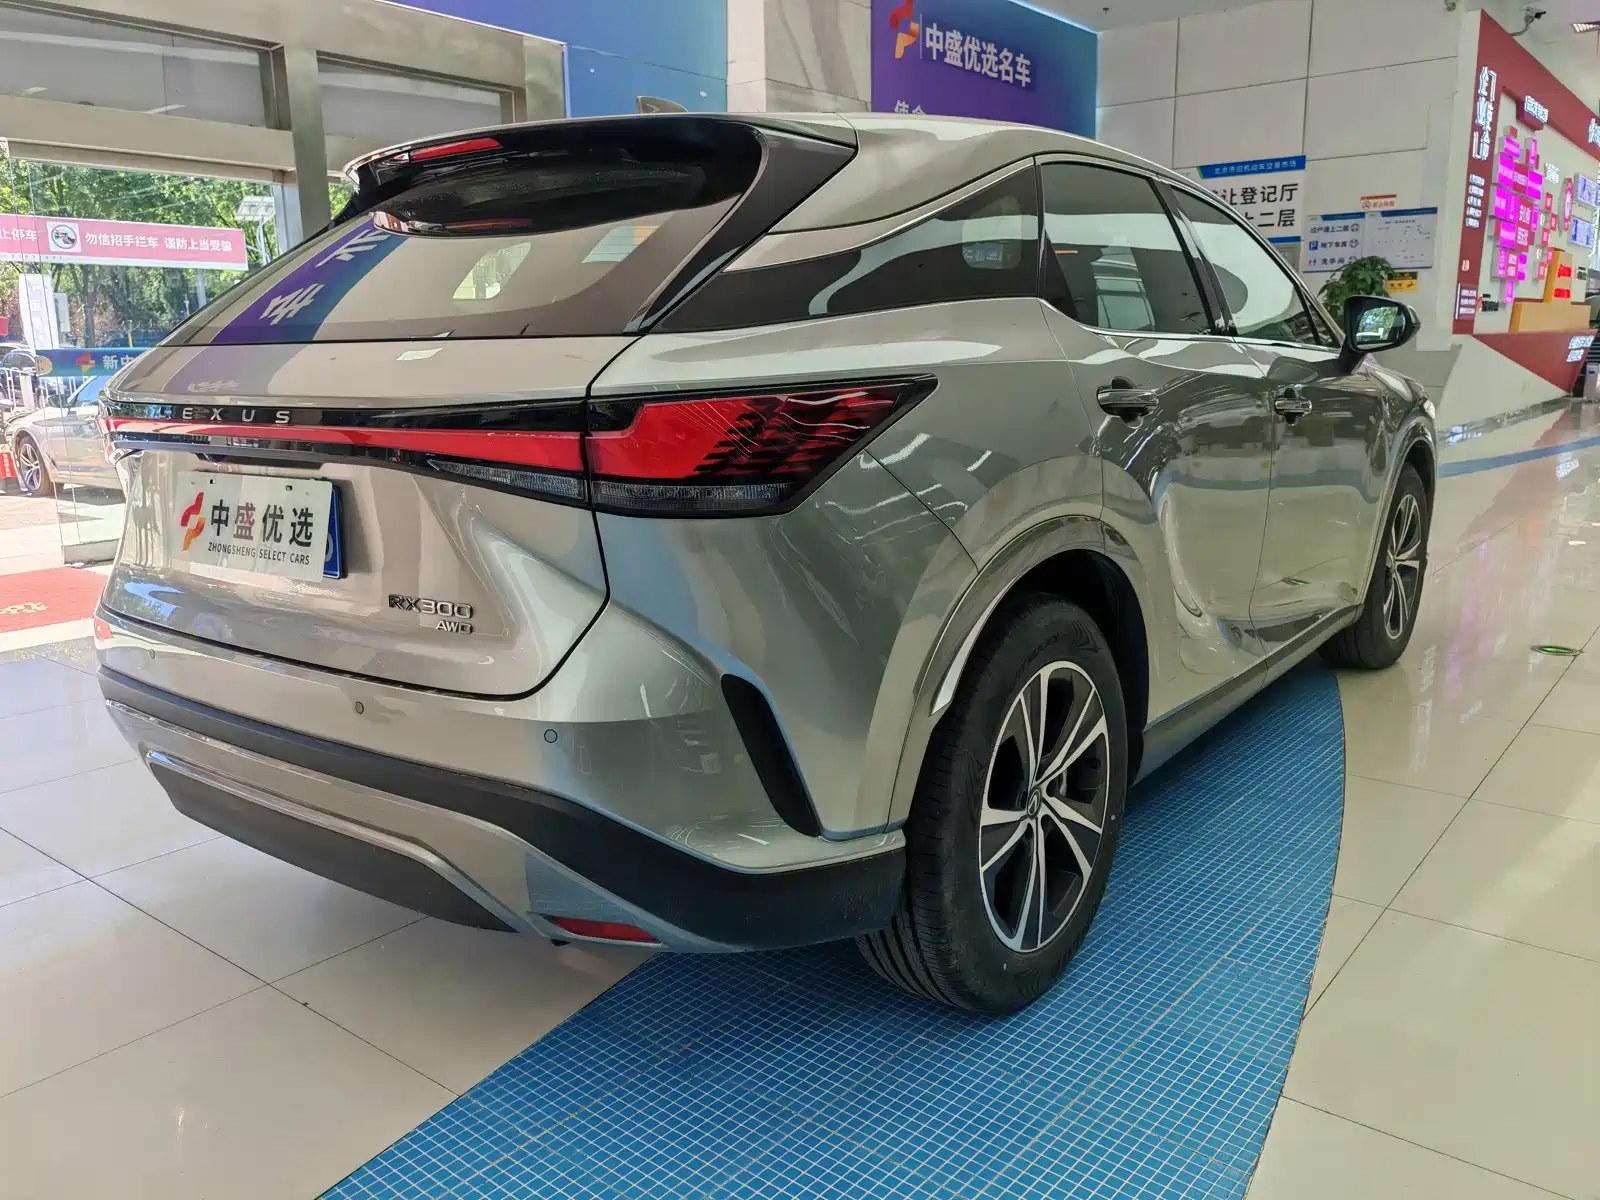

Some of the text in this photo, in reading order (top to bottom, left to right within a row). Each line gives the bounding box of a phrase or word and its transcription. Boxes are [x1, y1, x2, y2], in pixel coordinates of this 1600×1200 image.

[925, 22, 1032, 88] 中盛优选名车
[1212, 183, 1299, 206] 让登记厅
[84, 232, 159, 249] 勿信招手拦车
[158, 406, 291, 425] LEXUS
[210, 499, 314, 548] 中盛优选
[208, 542, 310, 566] ZHONGSHENG SELECT CARS
[435, 619, 473, 634] AWD
